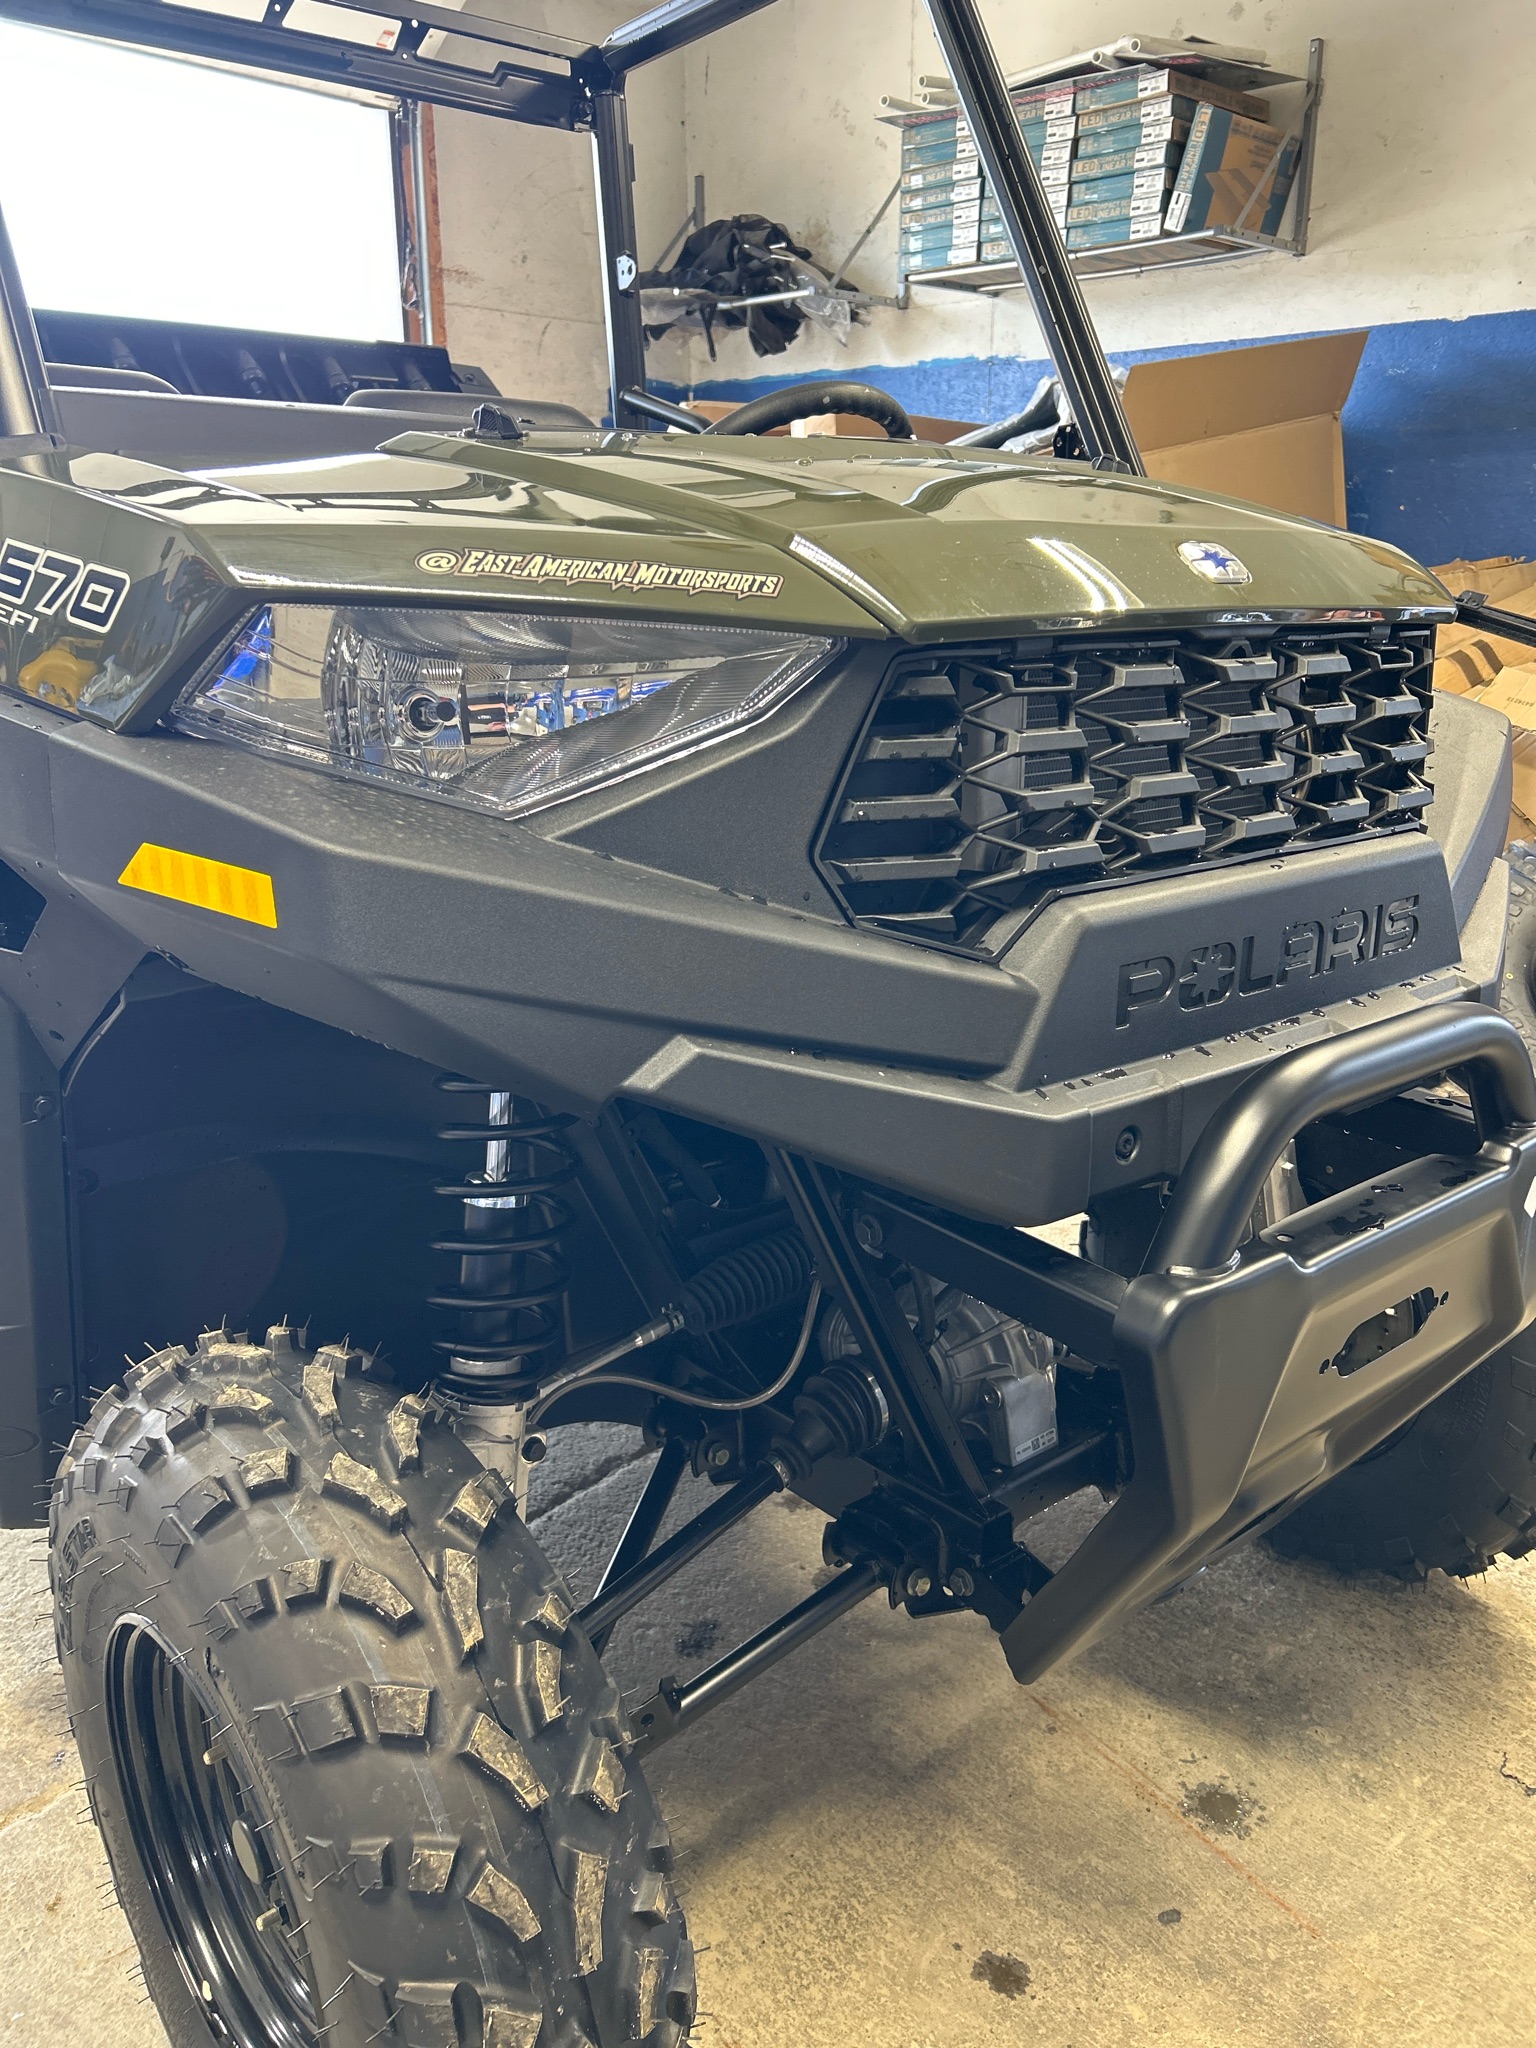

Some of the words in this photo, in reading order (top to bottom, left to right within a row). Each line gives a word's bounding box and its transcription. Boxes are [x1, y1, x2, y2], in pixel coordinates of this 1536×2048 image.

[1081, 113, 1101, 127] LED
[1194, 108, 1209, 139] LED
[1075, 160, 1096, 174] LED
[1070, 207, 1091, 220] LED
[0, 537, 130, 634] 570
[1115, 894, 1420, 1030] POLARIS
